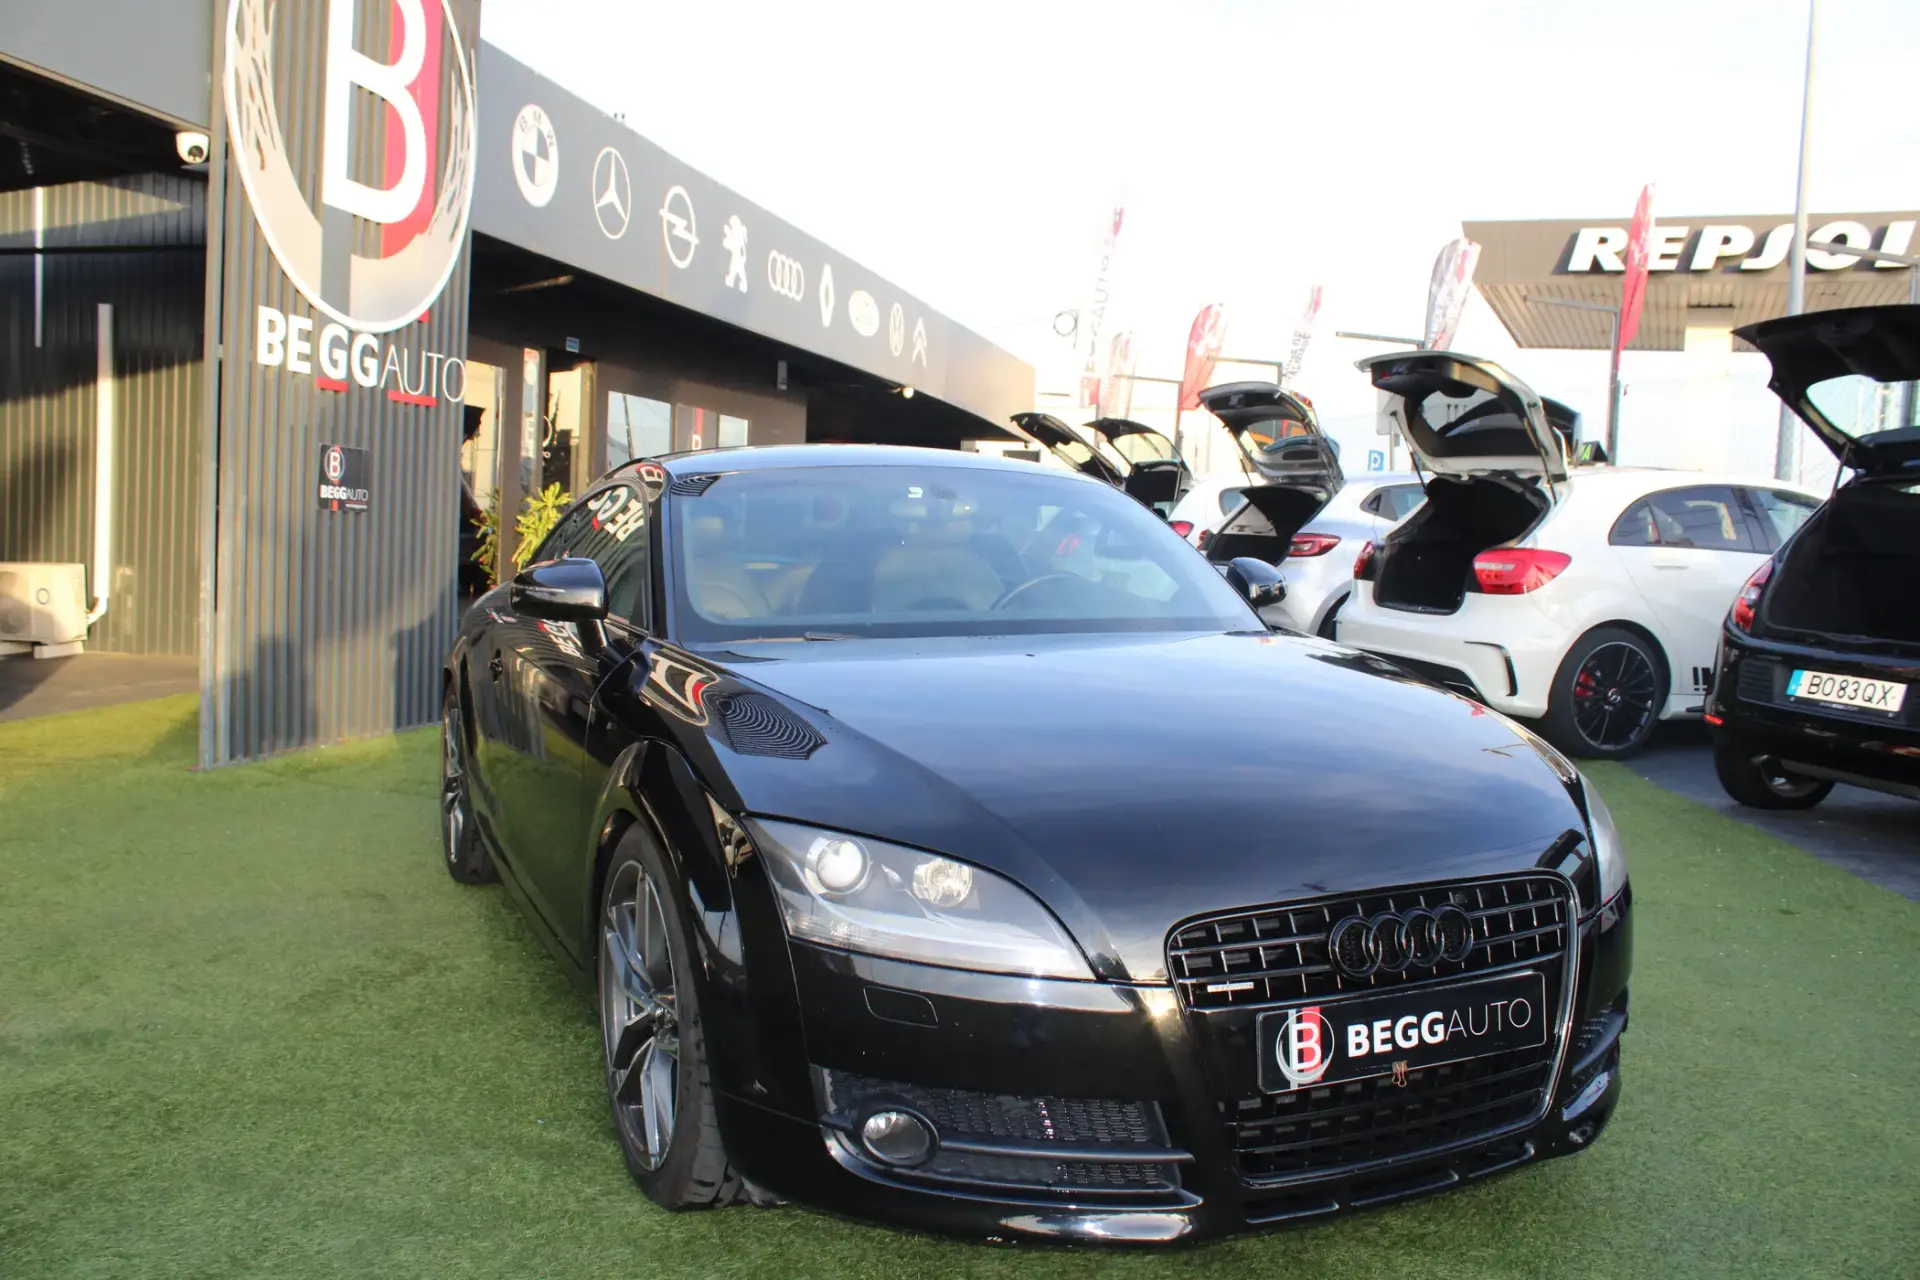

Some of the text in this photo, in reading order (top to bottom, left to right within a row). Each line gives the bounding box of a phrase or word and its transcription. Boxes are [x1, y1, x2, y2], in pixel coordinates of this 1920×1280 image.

[256, 304, 467, 404] BEGGAUTO
[319, 485, 369, 502] BEGGAUTO
[1347, 998, 1532, 1058] BEGGAUTO
